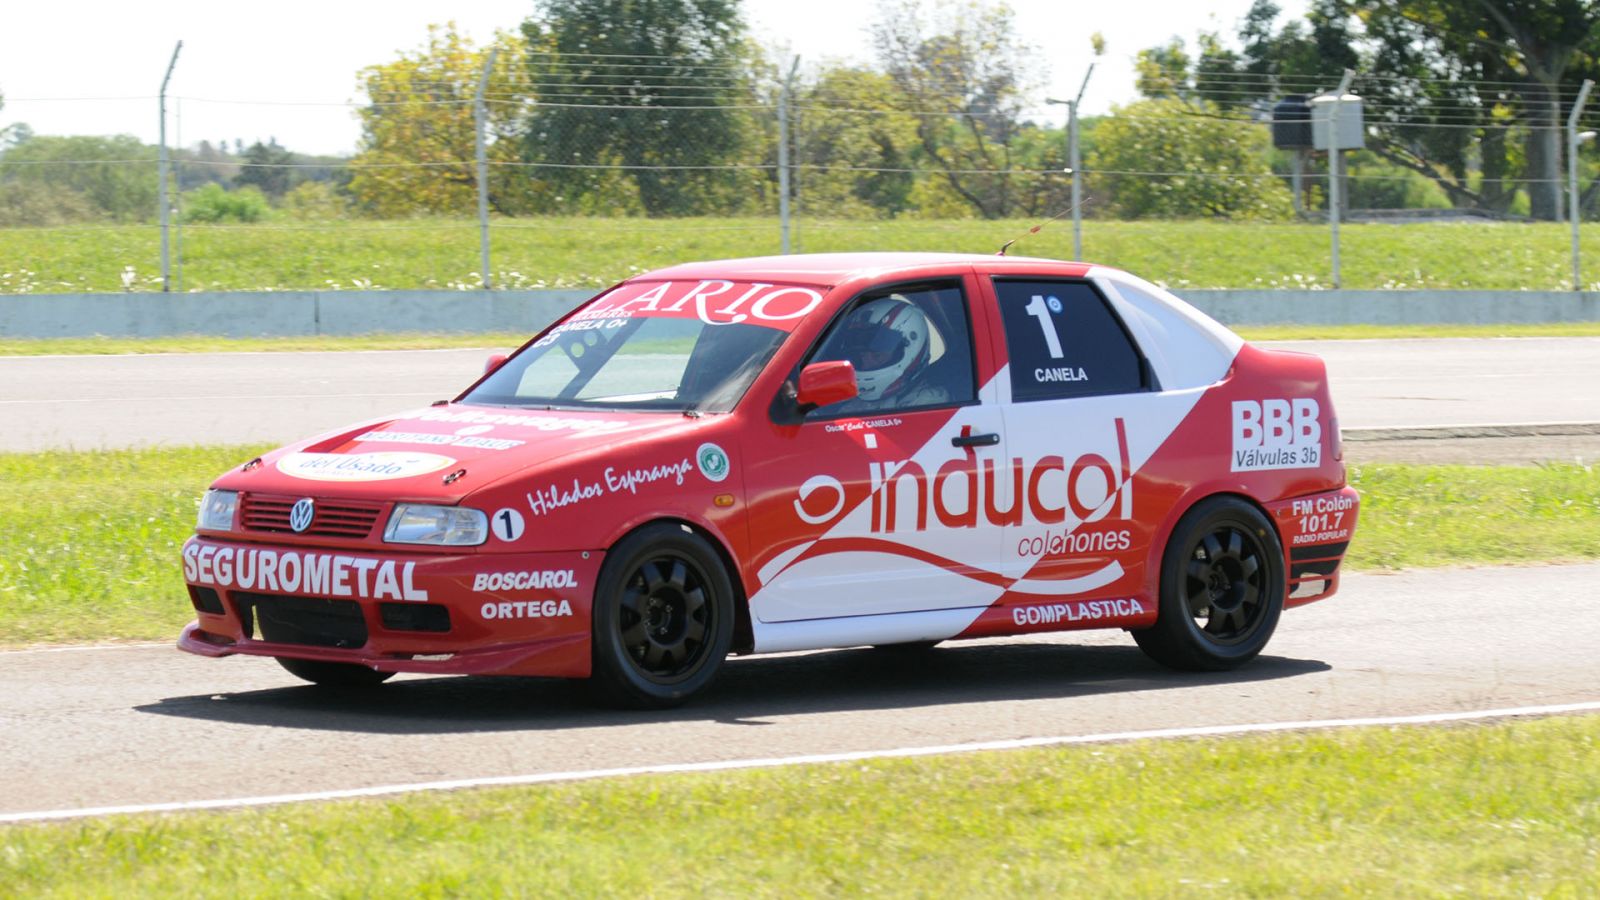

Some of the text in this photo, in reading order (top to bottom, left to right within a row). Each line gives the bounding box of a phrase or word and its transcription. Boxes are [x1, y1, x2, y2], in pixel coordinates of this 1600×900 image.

[1034, 367, 1088, 382] CANELA
[865, 419, 894, 428] CANELA
[1231, 398, 1321, 446] BBB
[335, 455, 403, 474] Usado
[1236, 447, 1318, 467] Válvulas 3b
[864, 418, 1133, 533] inducol
[527, 478, 603, 516] Hilados
[604, 458, 693, 494] Esperanza
[1292, 495, 1352, 516] FM Colón
[499, 510, 514, 539] 1
[1299, 512, 1344, 532] 101.7
[1018, 529, 1130, 556] colchones
[1293, 529, 1348, 544] RADIO POPULAR
[183, 543, 428, 602] SEGUROMETAL
[473, 569, 578, 592] BOSCAROL
[481, 600, 573, 619] ORTEGA
[1012, 598, 1144, 625] GOMPLASTICA
